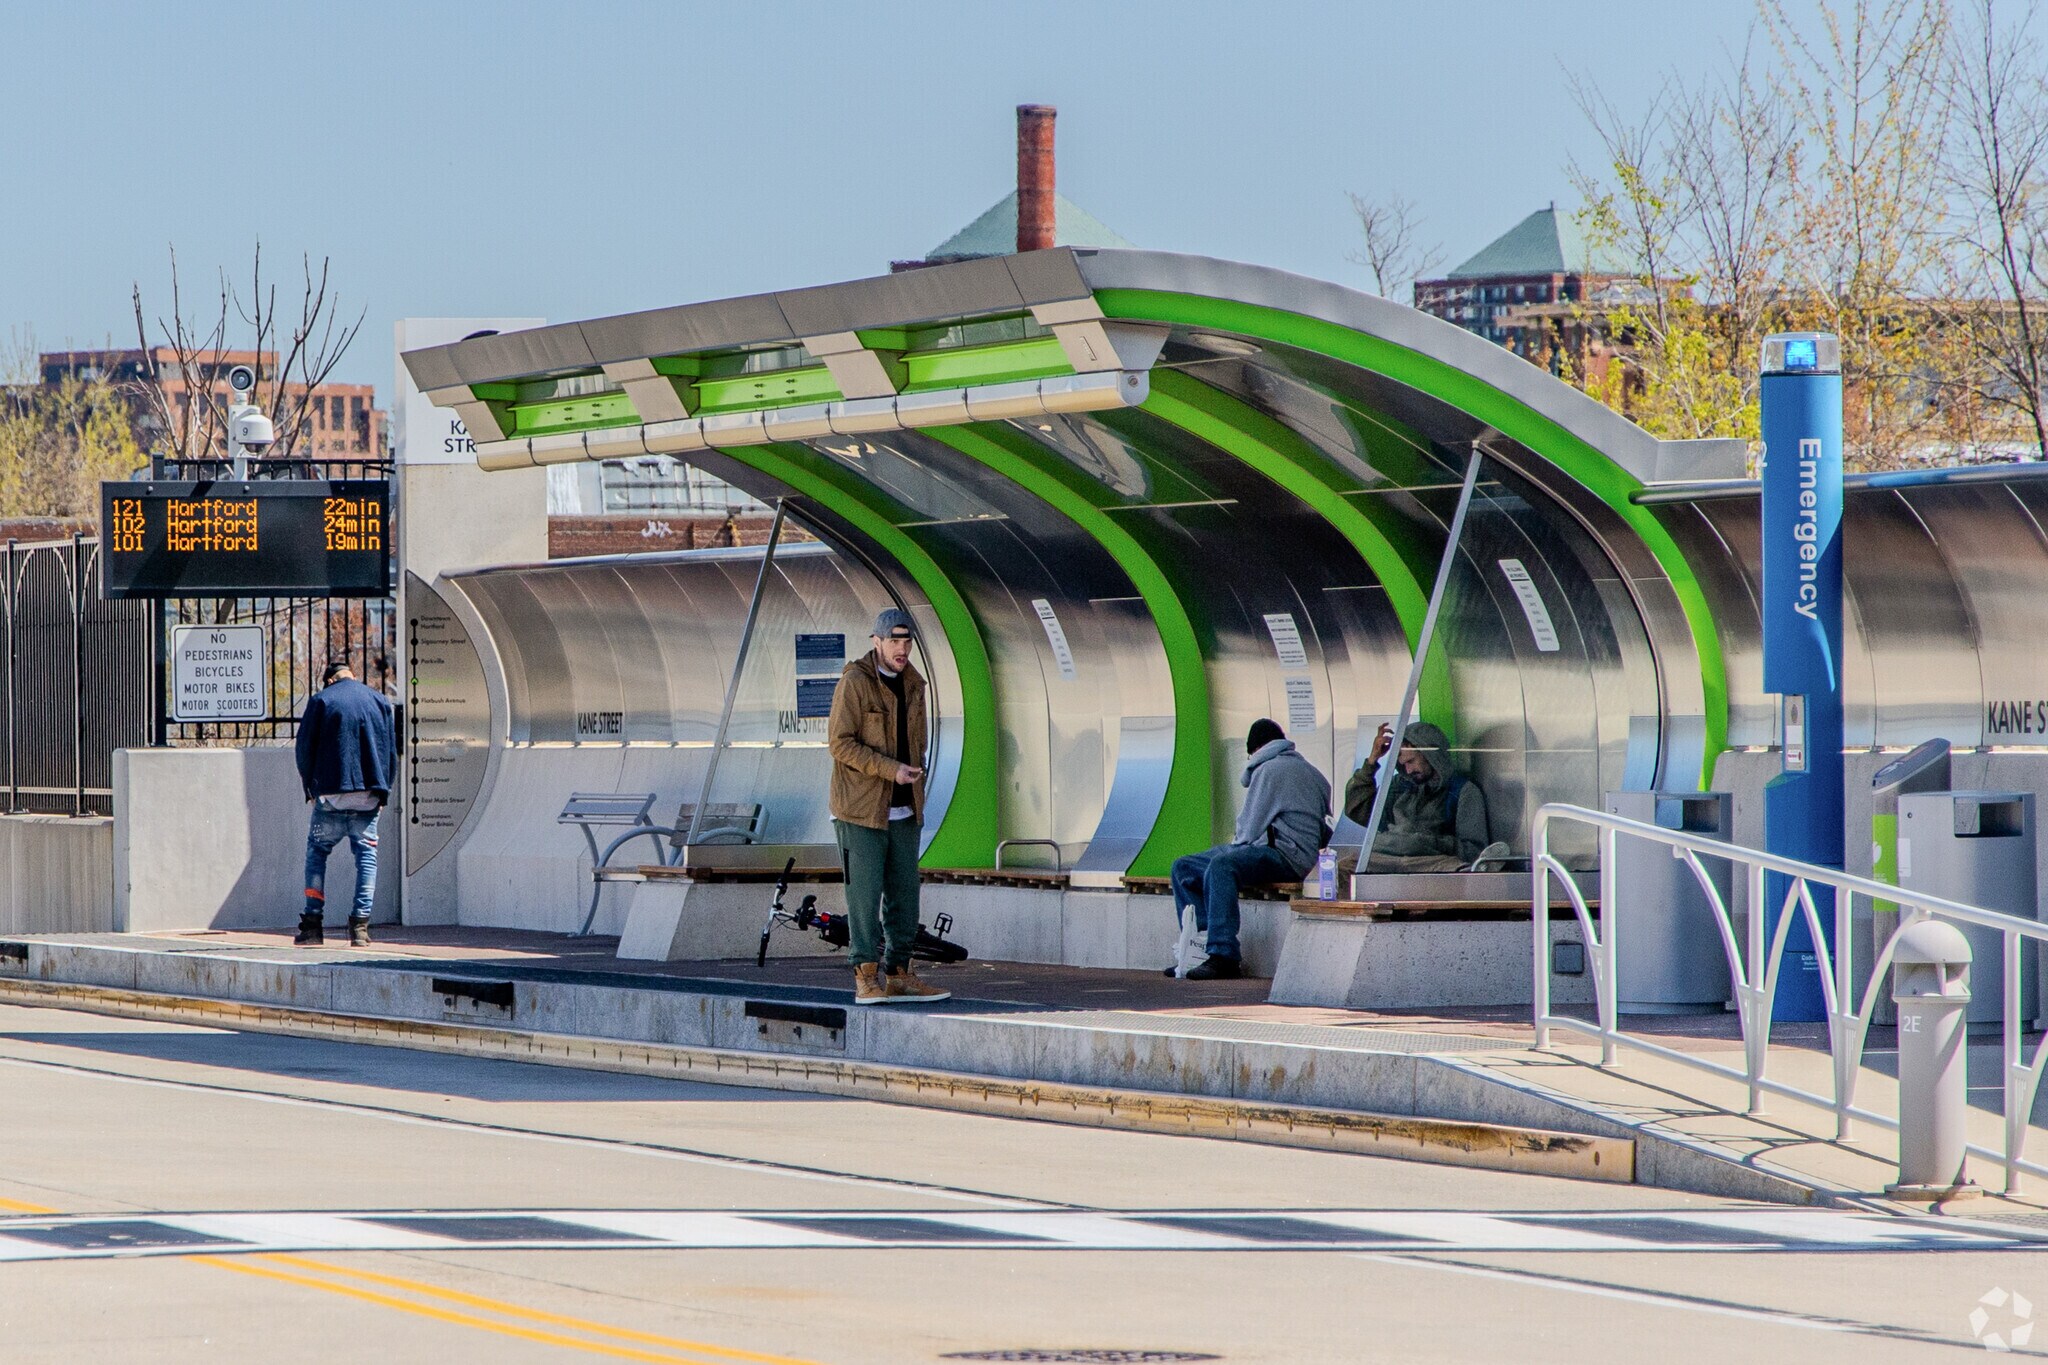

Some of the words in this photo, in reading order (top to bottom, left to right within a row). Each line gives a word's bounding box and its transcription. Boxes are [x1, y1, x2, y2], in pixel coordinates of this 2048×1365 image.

[242, 426, 249, 436] 9
[112, 499, 143, 516] 121
[167, 498, 258, 516] Hartford
[323, 498, 380, 515] 22min
[112, 517, 146, 533] 102
[167, 516, 258, 533] Hartford
[323, 515, 380, 532] 24min
[1793, 438, 1822, 620] Emergency
[112, 534, 144, 551] 101
[167, 533, 258, 551] Hartford
[325, 532, 381, 550] 19min
[210, 633, 227, 644] NO
[185, 649, 253, 661] PEDESTRIANS
[195, 666, 244, 677] BICYCLES
[184, 683, 218, 694] MOTOR
[226, 682, 255, 694] BIKES
[182, 700, 209, 711] MOTOR
[217, 699, 258, 710] SCOOTERS
[577, 712, 597, 734] KANE
[598, 712, 623, 734] STREET
[778, 710, 801, 733] KANE
[1988, 700, 2032, 734] KANE
[2037, 700, 2048, 735] S
[1903, 1015, 1922, 1033] 2E
